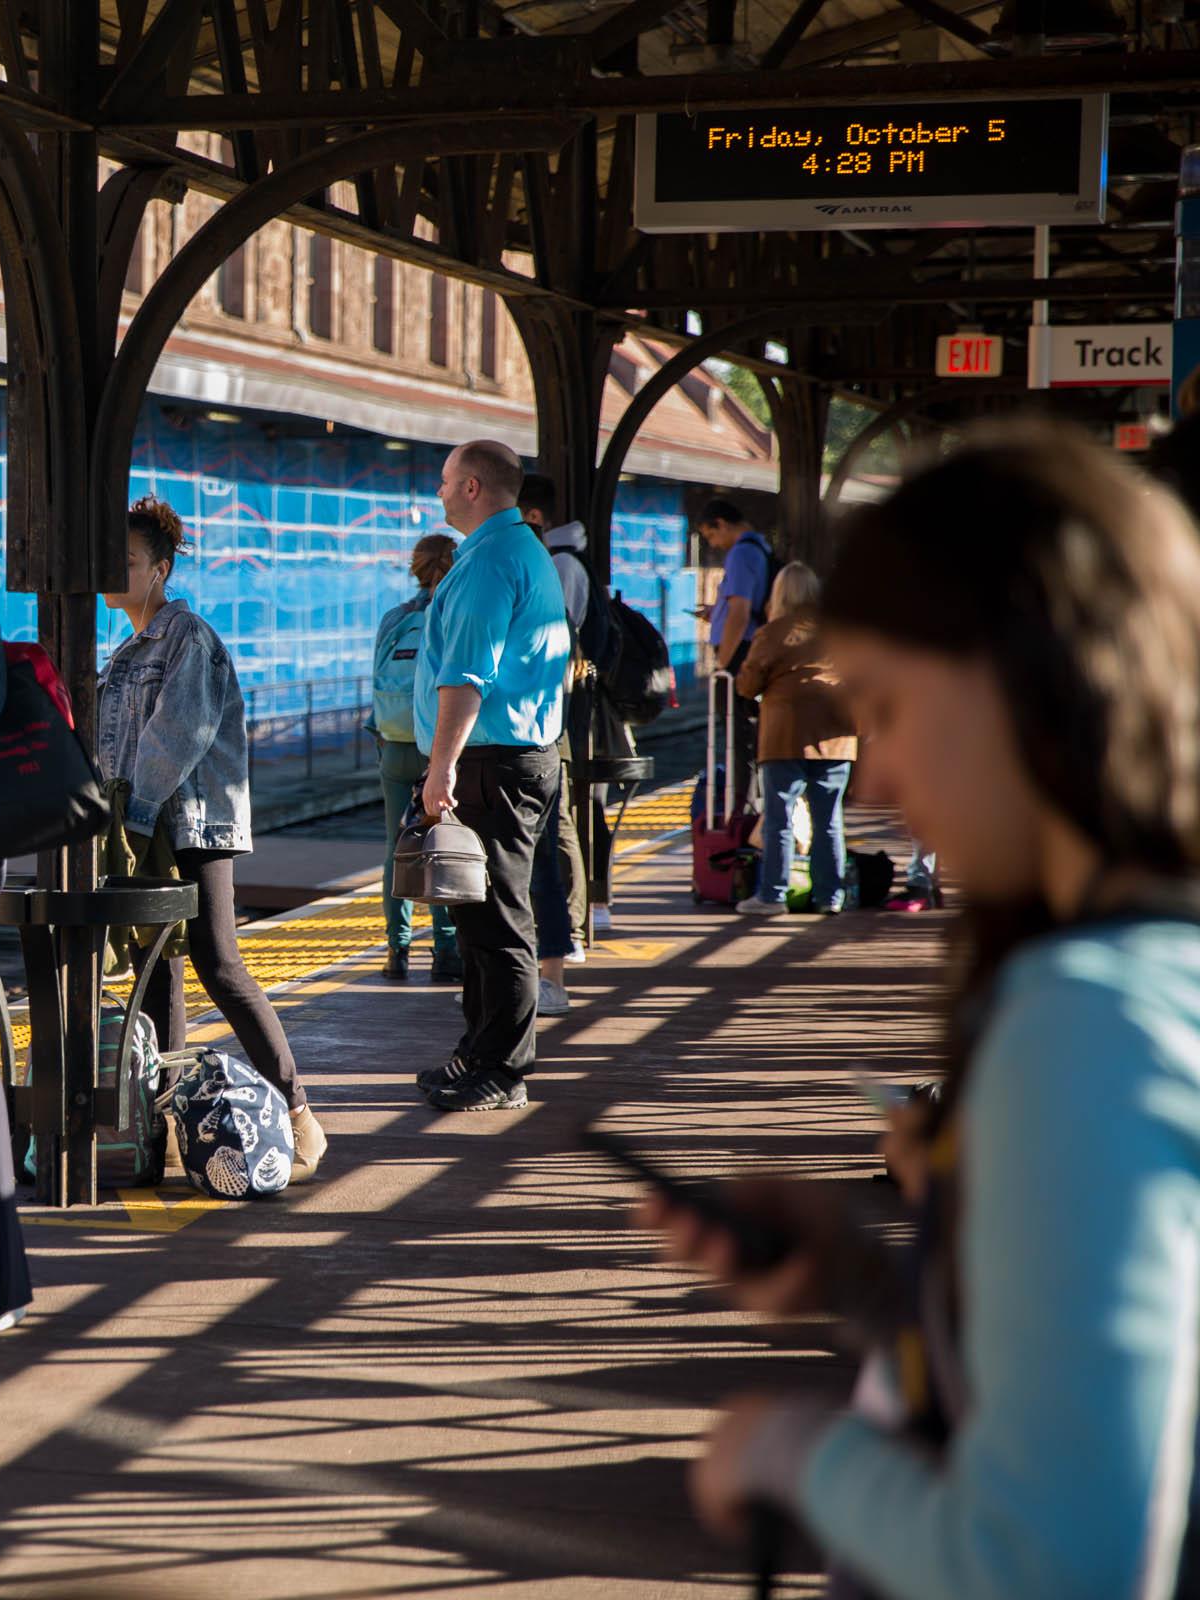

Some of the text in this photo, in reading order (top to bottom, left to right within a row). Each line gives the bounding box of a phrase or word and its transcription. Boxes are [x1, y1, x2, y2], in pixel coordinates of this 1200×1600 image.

[708, 119, 1006, 150] Friday, October 5
[802, 150, 925, 175] 4:28 PM
[841, 204, 913, 214] AMTRAK
[947, 338, 993, 373] EXIT
[1074, 336, 1163, 367] Track
